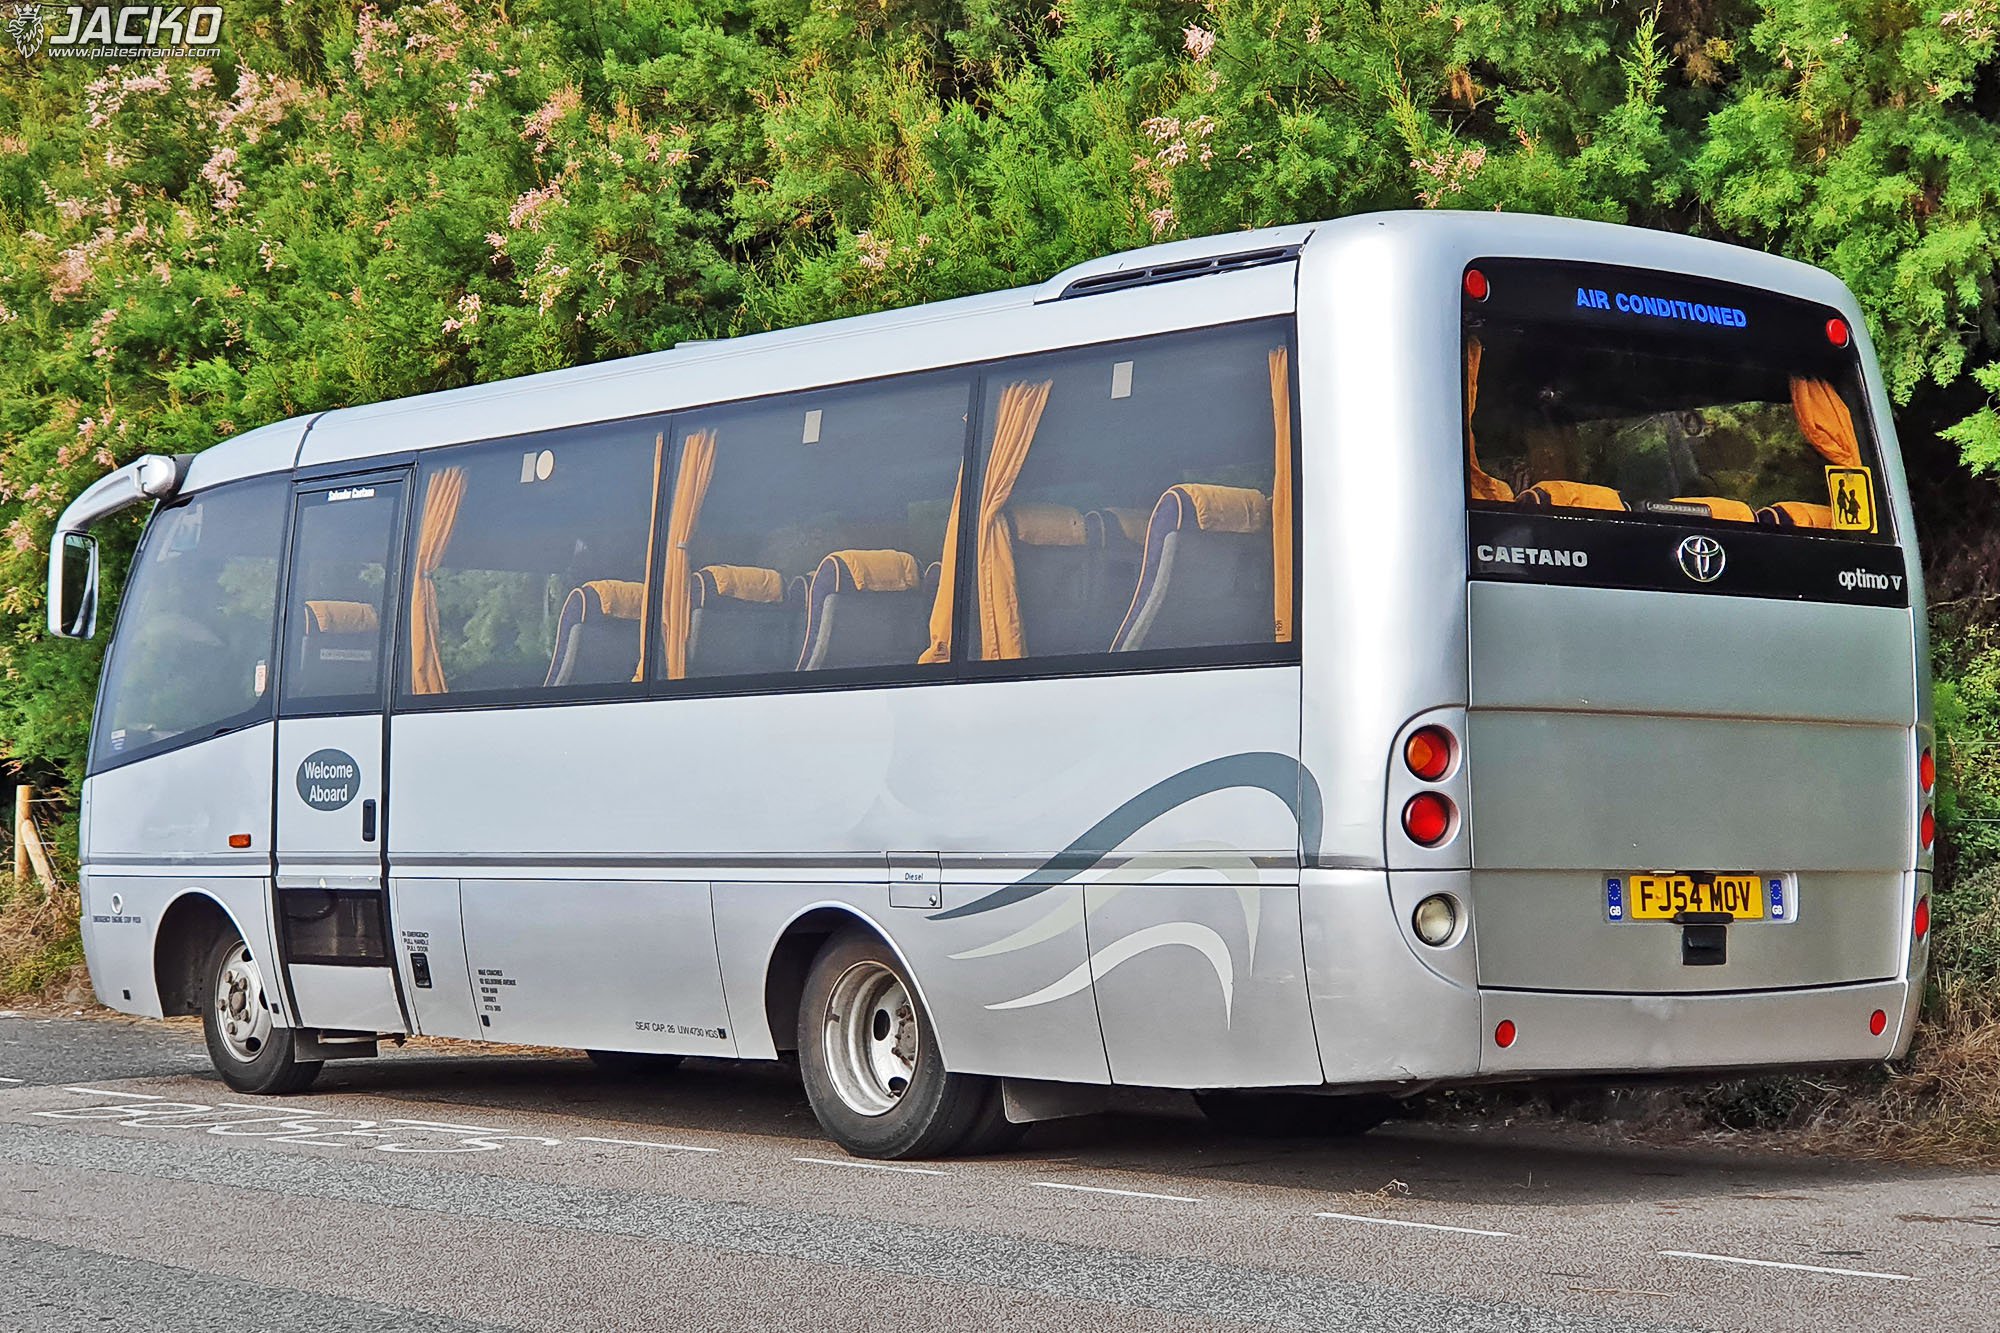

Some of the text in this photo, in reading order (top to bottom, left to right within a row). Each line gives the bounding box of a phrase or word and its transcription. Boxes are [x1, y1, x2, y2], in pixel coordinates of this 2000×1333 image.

[1577, 287, 1747, 328] AIR CONDITIONED
[1477, 544, 1588, 568] CAETANO
[1838, 567, 1889, 591] optimo
[304, 761, 353, 779] Welcome
[309, 783, 348, 802] Aboard
[904, 872, 924, 881] Diesel
[1640, 880, 1751, 912] FJ54 MOV
[1609, 906, 1622, 916] GB
[1772, 905, 1784, 915] GB
[635, 1021, 650, 1031] SEAT
[31, 1102, 561, 1154] BUSES
